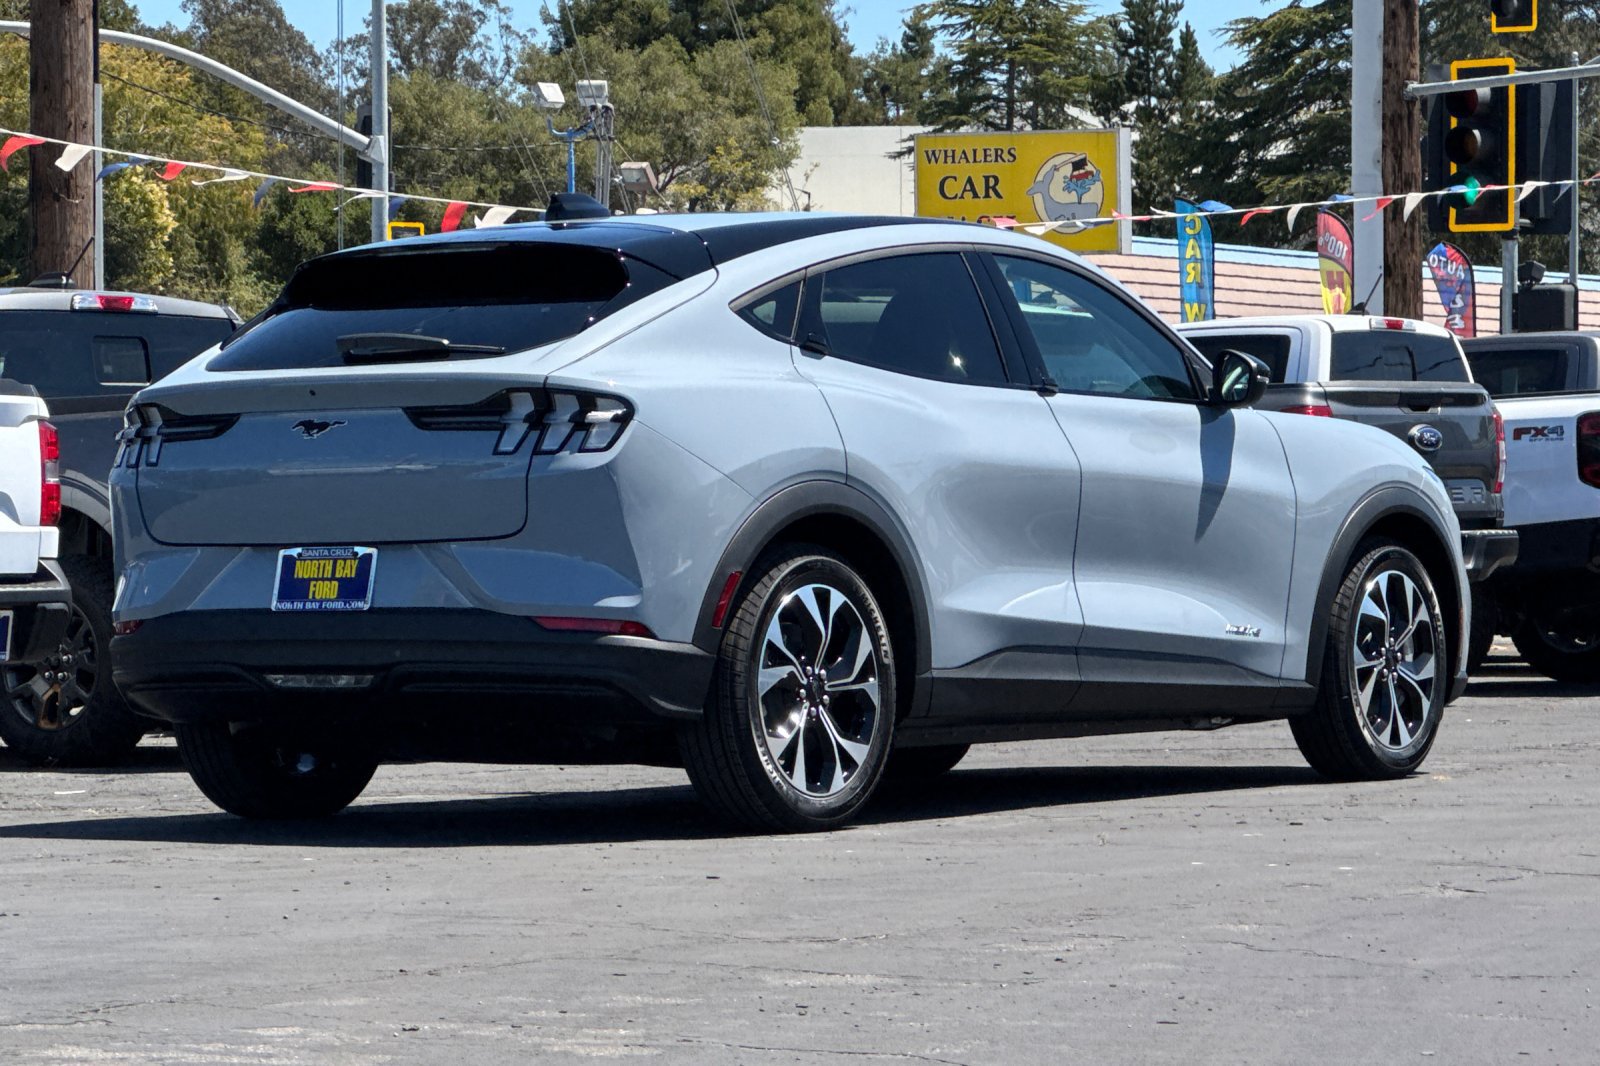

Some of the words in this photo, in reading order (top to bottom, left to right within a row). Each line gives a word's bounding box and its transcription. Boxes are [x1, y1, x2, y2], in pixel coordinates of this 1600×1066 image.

[924, 147, 1017, 164] WHALERS
[938, 175, 1003, 200] CAR
[1513, 425, 1564, 440] FX4
[302, 549, 329, 557] SANTA
[330, 548, 353, 556] CRUZ
[294, 560, 333, 578] NORTH
[335, 560, 358, 577] BAY
[308, 581, 339, 599] FORD
[276, 601, 303, 610] NORTH
[305, 601, 320, 609] BAY
